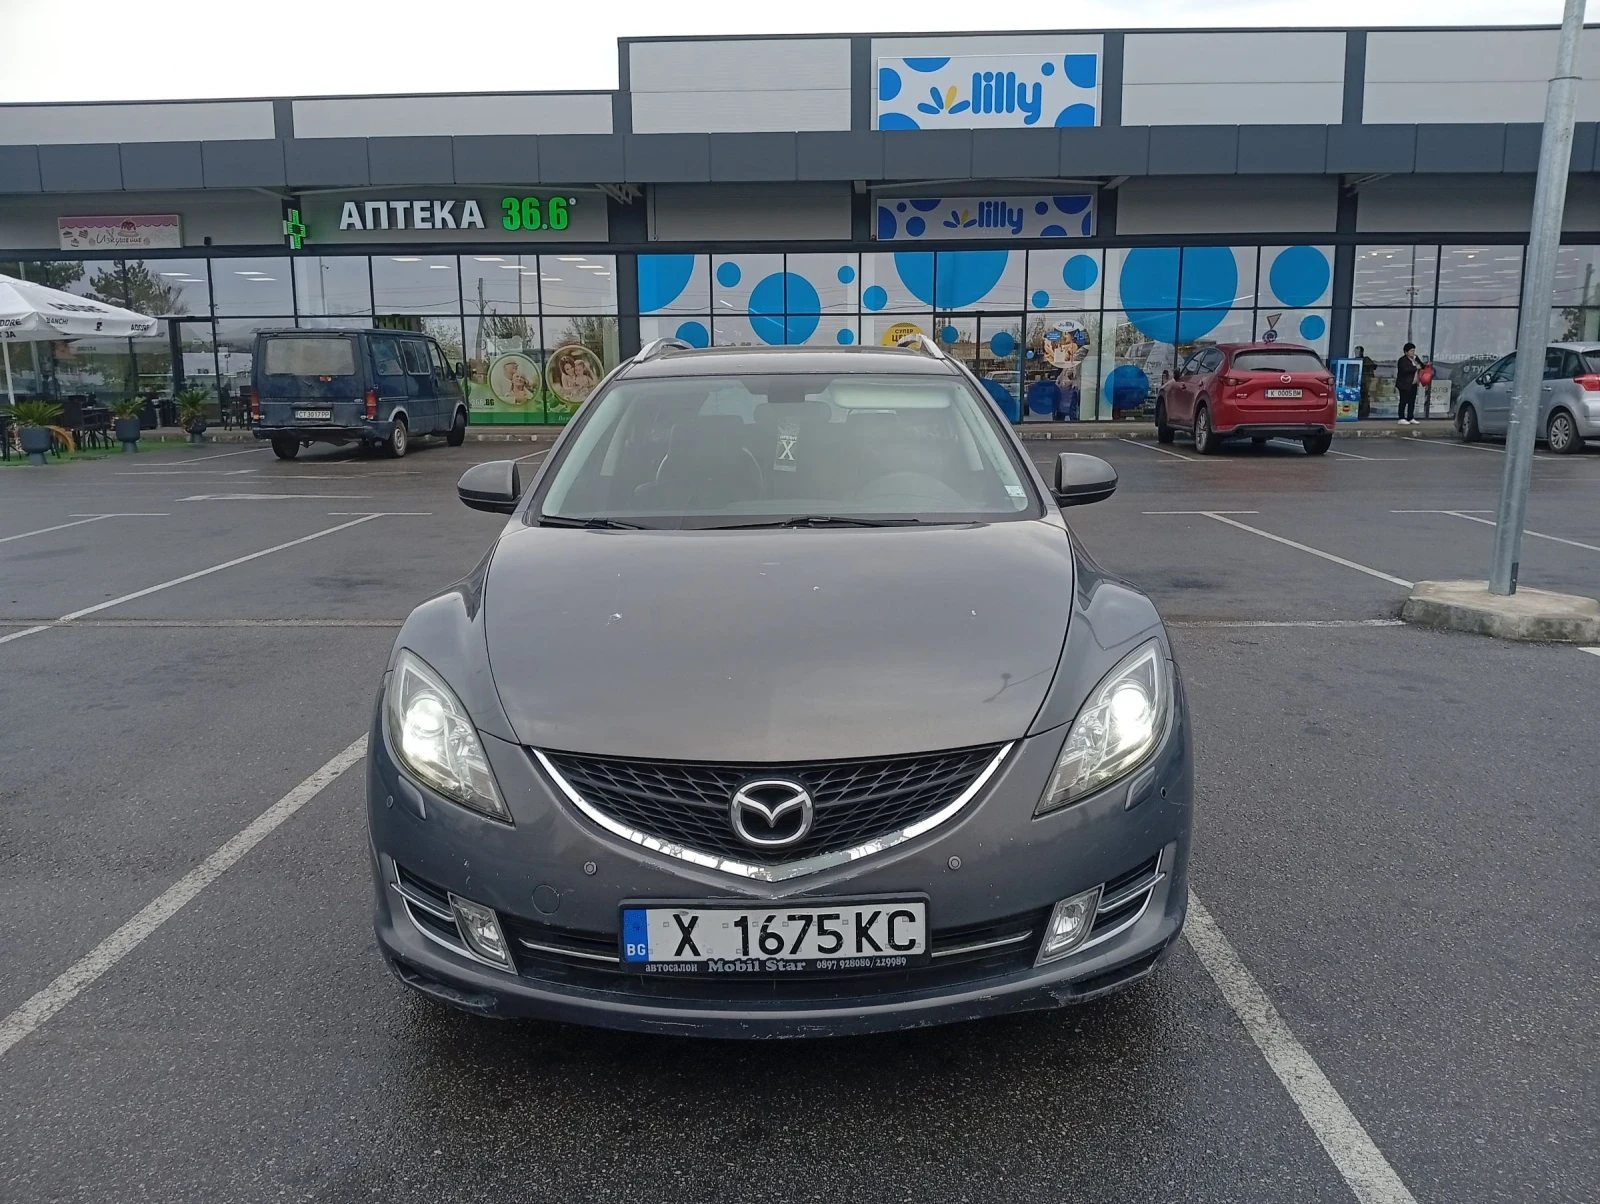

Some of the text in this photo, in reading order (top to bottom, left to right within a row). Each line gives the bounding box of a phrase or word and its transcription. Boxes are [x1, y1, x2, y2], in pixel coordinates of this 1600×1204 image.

[971, 71, 1042, 125] lilly
[339, 200, 485, 230] АПТЕКА
[978, 201, 1023, 235] lilly
[626, 909, 917, 957] BG X 1675 KC
[645, 962, 698, 972] автосалон
[707, 959, 760, 972] Mobil
[765, 958, 806, 972] Star
[816, 959, 837, 969] 0897
